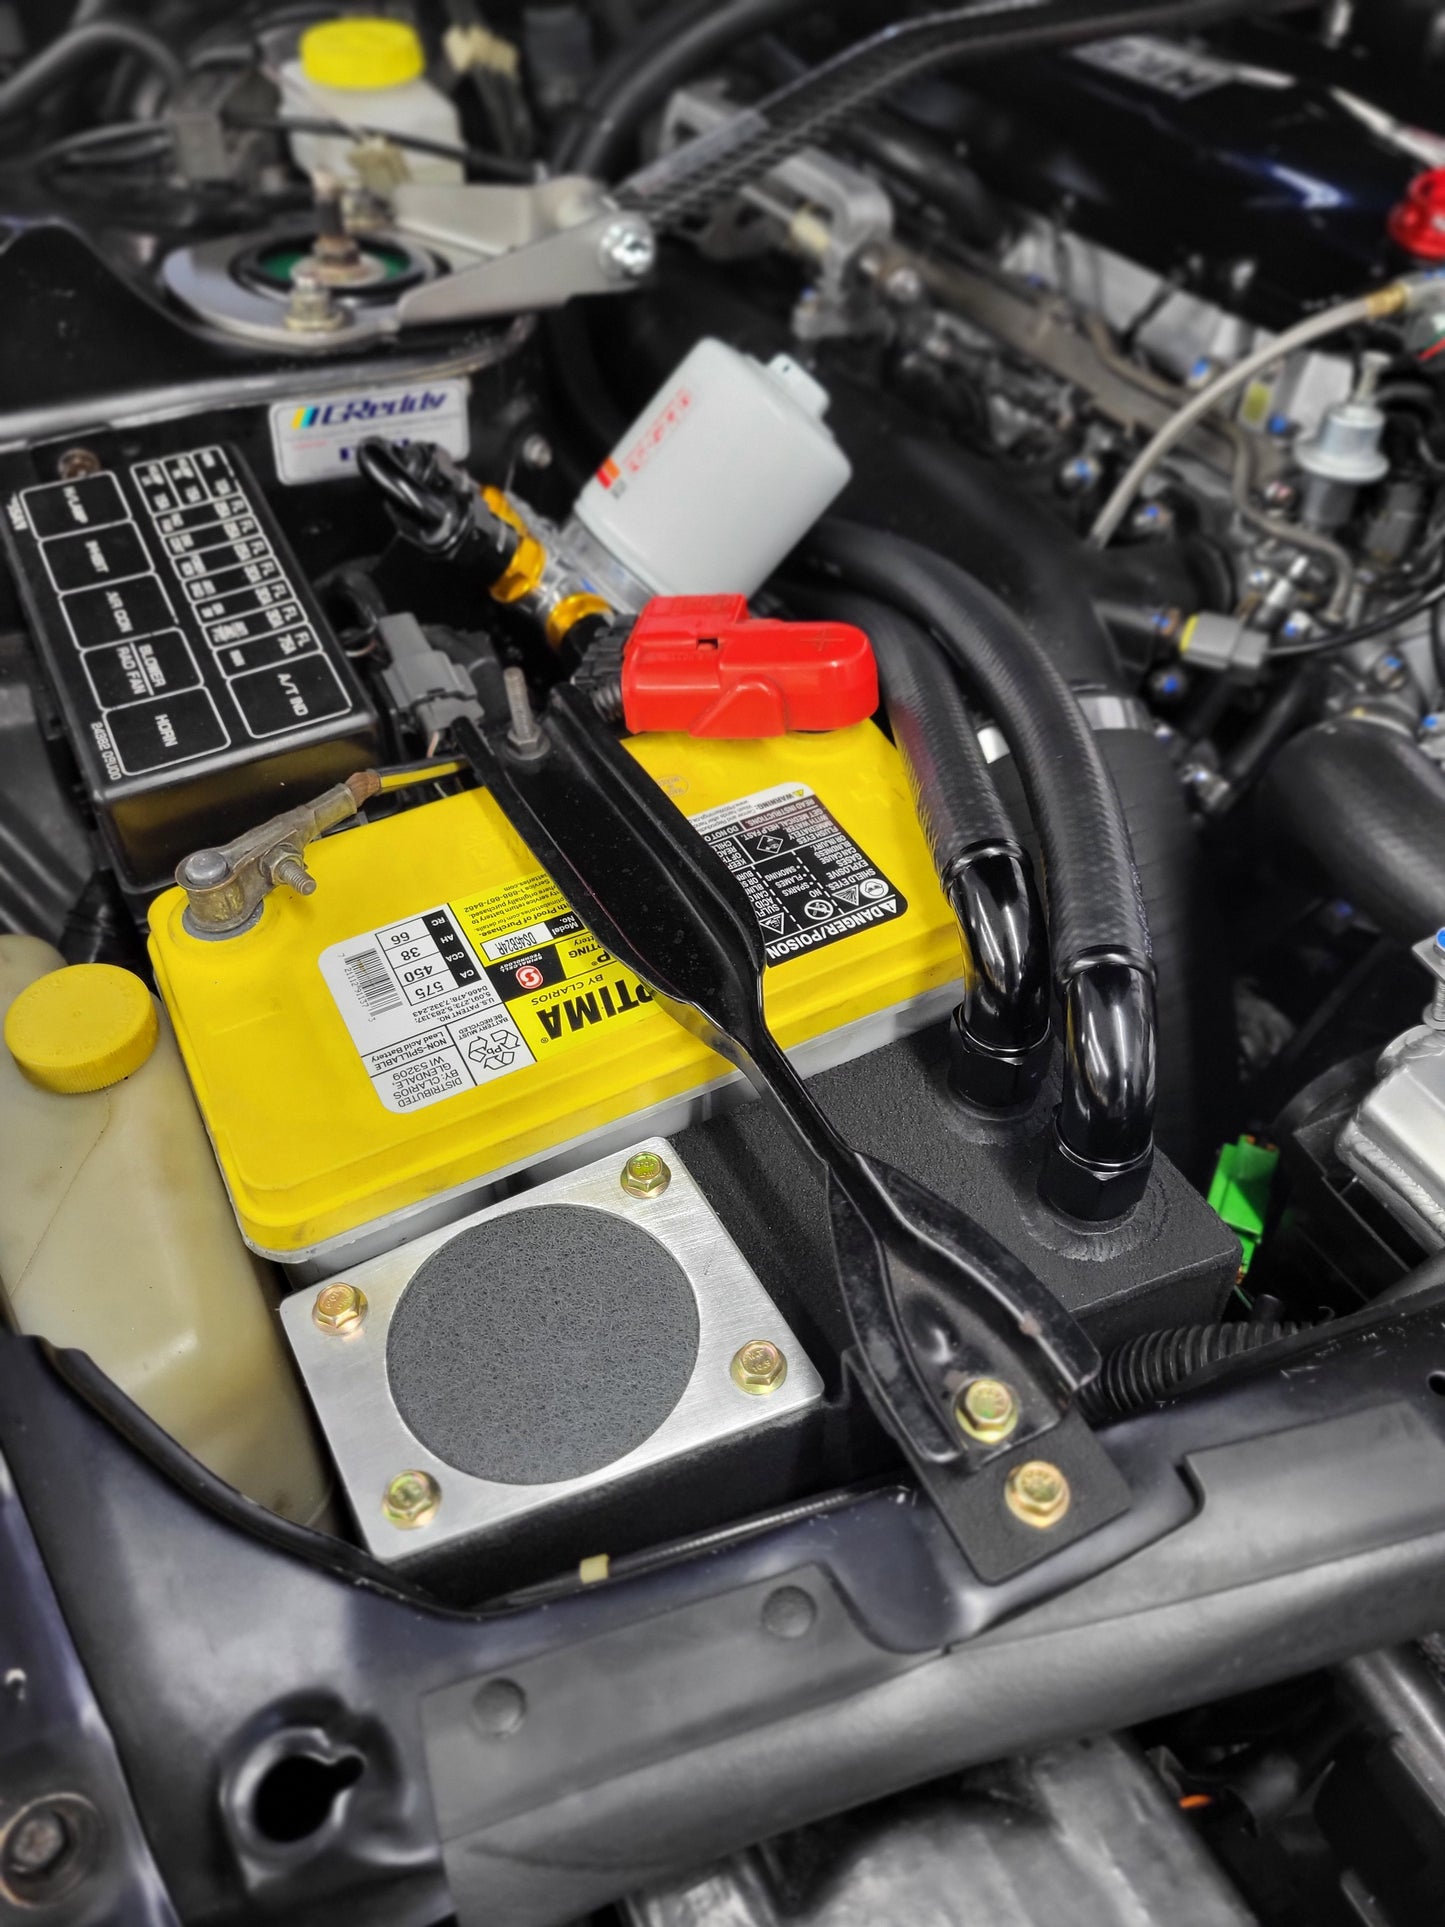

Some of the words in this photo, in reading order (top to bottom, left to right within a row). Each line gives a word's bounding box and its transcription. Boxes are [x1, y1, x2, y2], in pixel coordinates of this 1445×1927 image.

[277, 633, 296, 654] 75A
[117, 646, 136, 670] RAD
[138, 644, 166, 687] BLOWER
[126, 670, 146, 694] FAN
[277, 673, 299, 695] A/T
[289, 695, 308, 716] IND
[154, 713, 178, 747] HORN
[756, 792, 794, 810] WARNING:
[794, 798, 815, 809] READ
[744, 804, 797, 829] INSTRUCTIONS.
[777, 812, 810, 827] MEDICAL
[807, 813, 829, 825] WITH
[808, 807, 823, 818] GET
[726, 824, 739, 834] DO
[760, 822, 780, 834] HELP
[782, 818, 811, 833] WATER.
[787, 817, 834, 840] IMMEDIATELY
[813, 825, 839, 838] FLUSH
[710, 829, 728, 840] NOT
[740, 828, 762, 841] FAST.
[795, 832, 816, 845] EYES
[834, 834, 846, 843] OR
[809, 837, 837, 851] INJURY.
[813, 839, 852, 858] BLINDNESS
[840, 846, 857, 856] CAN
[730, 851, 742, 860] OF
[818, 851, 843, 864] CAUSE
[835, 852, 862, 867] GASES
[726, 857, 747, 870] KEEP
[825, 858, 869, 880] EXPLOSIVE
[746, 876, 759, 885] OR
[763, 865, 797, 882] SMOKING
[774, 873, 804, 888] FLAMES
[847, 867, 876, 883] SHIELD
[524, 878, 550, 890] Service
[781, 881, 810, 897] SPARKS
[825, 877, 850, 891] EYES.
[506, 890, 538, 905] originally
[525, 893, 549, 905] service
[752, 889, 769, 900] CAN
[808, 887, 822, 898] NO
[469, 900, 507, 919] purchased.
[503, 901, 525, 913] return
[505, 895, 565, 920] ptimabatteries.com
[754, 896, 774, 909] ACID
[479, 909, 504, 922] battery
[522, 915, 532, 923] of
[532, 906, 557, 920] Proof
[558, 914, 575, 923] No.
[430, 916, 445, 926] RC
[480, 918, 522, 937] Purchase.
[550, 918, 579, 935] Model
[390, 931, 410, 945] 66
[439, 933, 454, 944] AH
[764, 905, 884, 959] DANGER/POISON
[496, 931, 537, 958] DS46B24R
[573, 934, 595, 946] ttery
[400, 946, 421, 961] 38
[444, 951, 464, 962] CCA
[403, 965, 433, 983] 450
[459, 969, 474, 978] CA
[587, 973, 604, 985] BY
[414, 980, 444, 1000] 575
[530, 981, 584, 1006] CLARIOS
[411, 999, 450, 1017] 7,332,243
[478, 996, 495, 1006] U.S.
[451, 1002, 480, 1018] PATENT
[535, 979, 654, 1041] PTIMA
[438, 1013, 451, 1022] NO.
[478, 1016, 509, 1032] BATTERY
[457, 1017, 492, 1034] RECYCLED
[422, 1030, 444, 1043] Lead
[458, 1028, 478, 1040] MUST
[402, 1038, 422, 1051] Acid
[485, 1044, 503, 1055] Pb
[371, 1046, 403, 1063] Battery
[373, 1037, 447, 1071] NON-SPILLABLE
[428, 1055, 444, 1067] WI
[391, 1061, 429, 1081] 53209
[394, 1061, 451, 1090] GLENDALE,
[440, 1068, 459, 1081] BY:
[392, 1075, 441, 1100] CLARIOS
[397, 1076, 463, 1108] DISTRIBUTED
